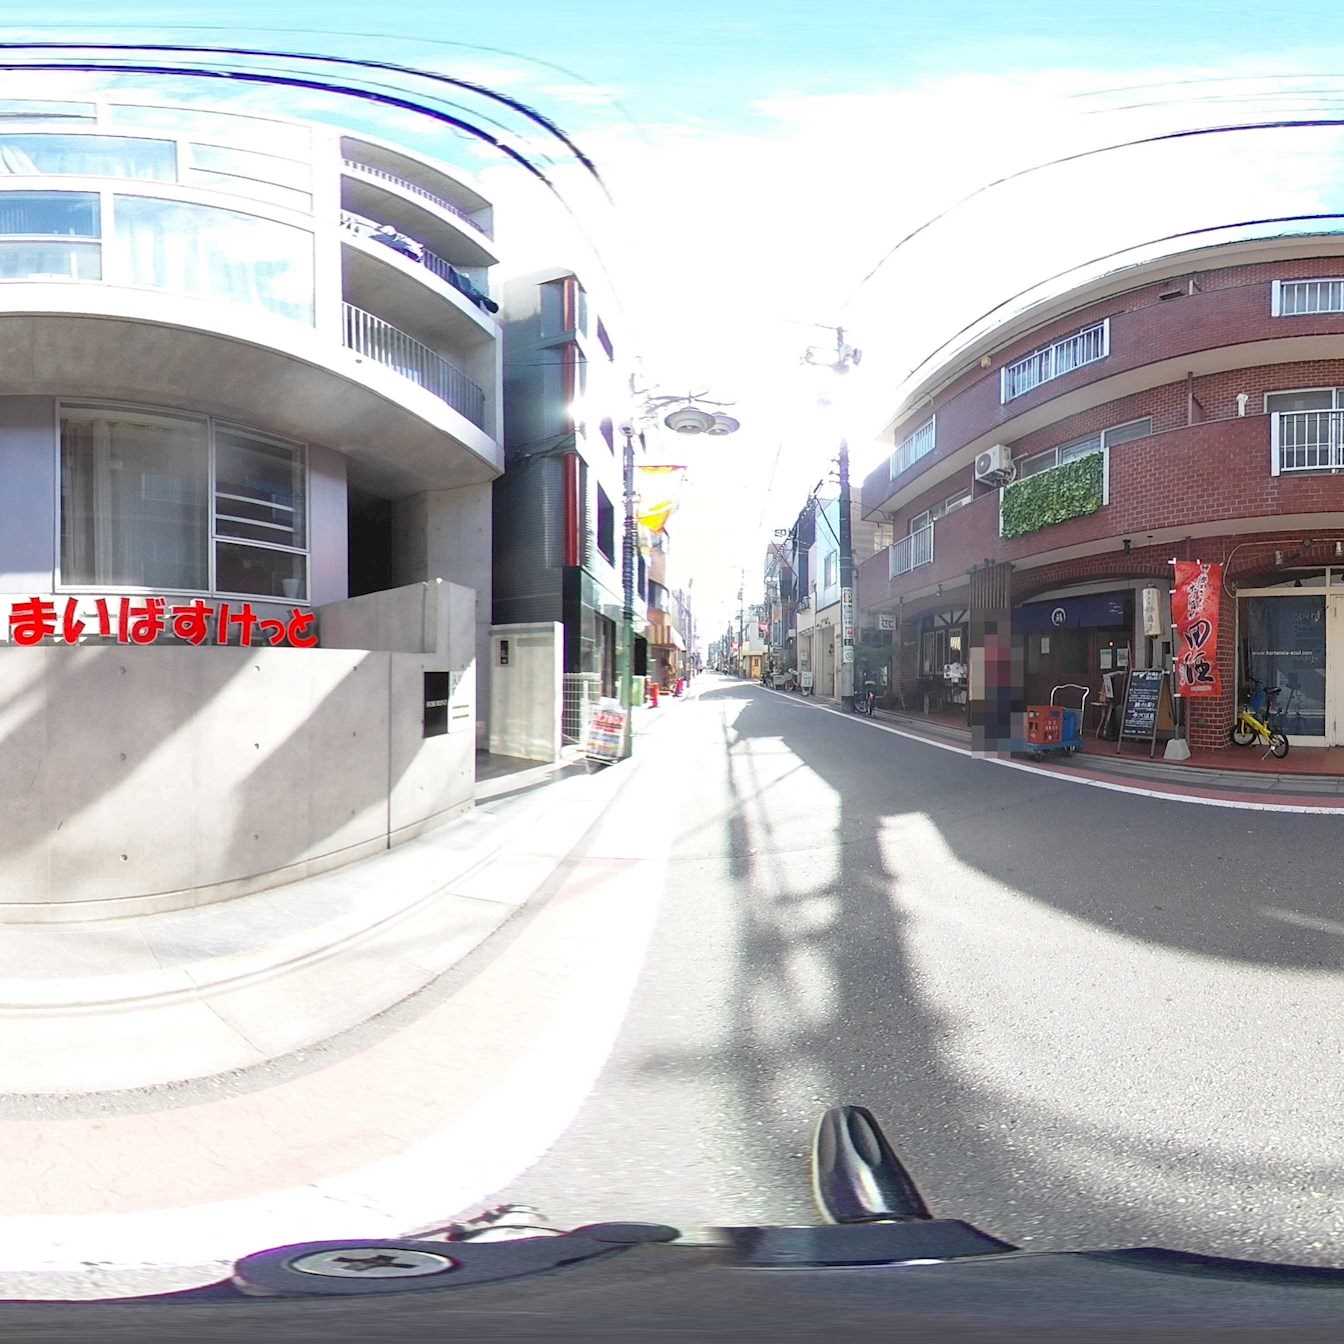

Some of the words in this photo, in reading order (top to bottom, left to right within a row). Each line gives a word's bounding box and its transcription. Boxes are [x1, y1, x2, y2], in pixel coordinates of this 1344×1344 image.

[8, 596, 319, 648] まいばすけっと
